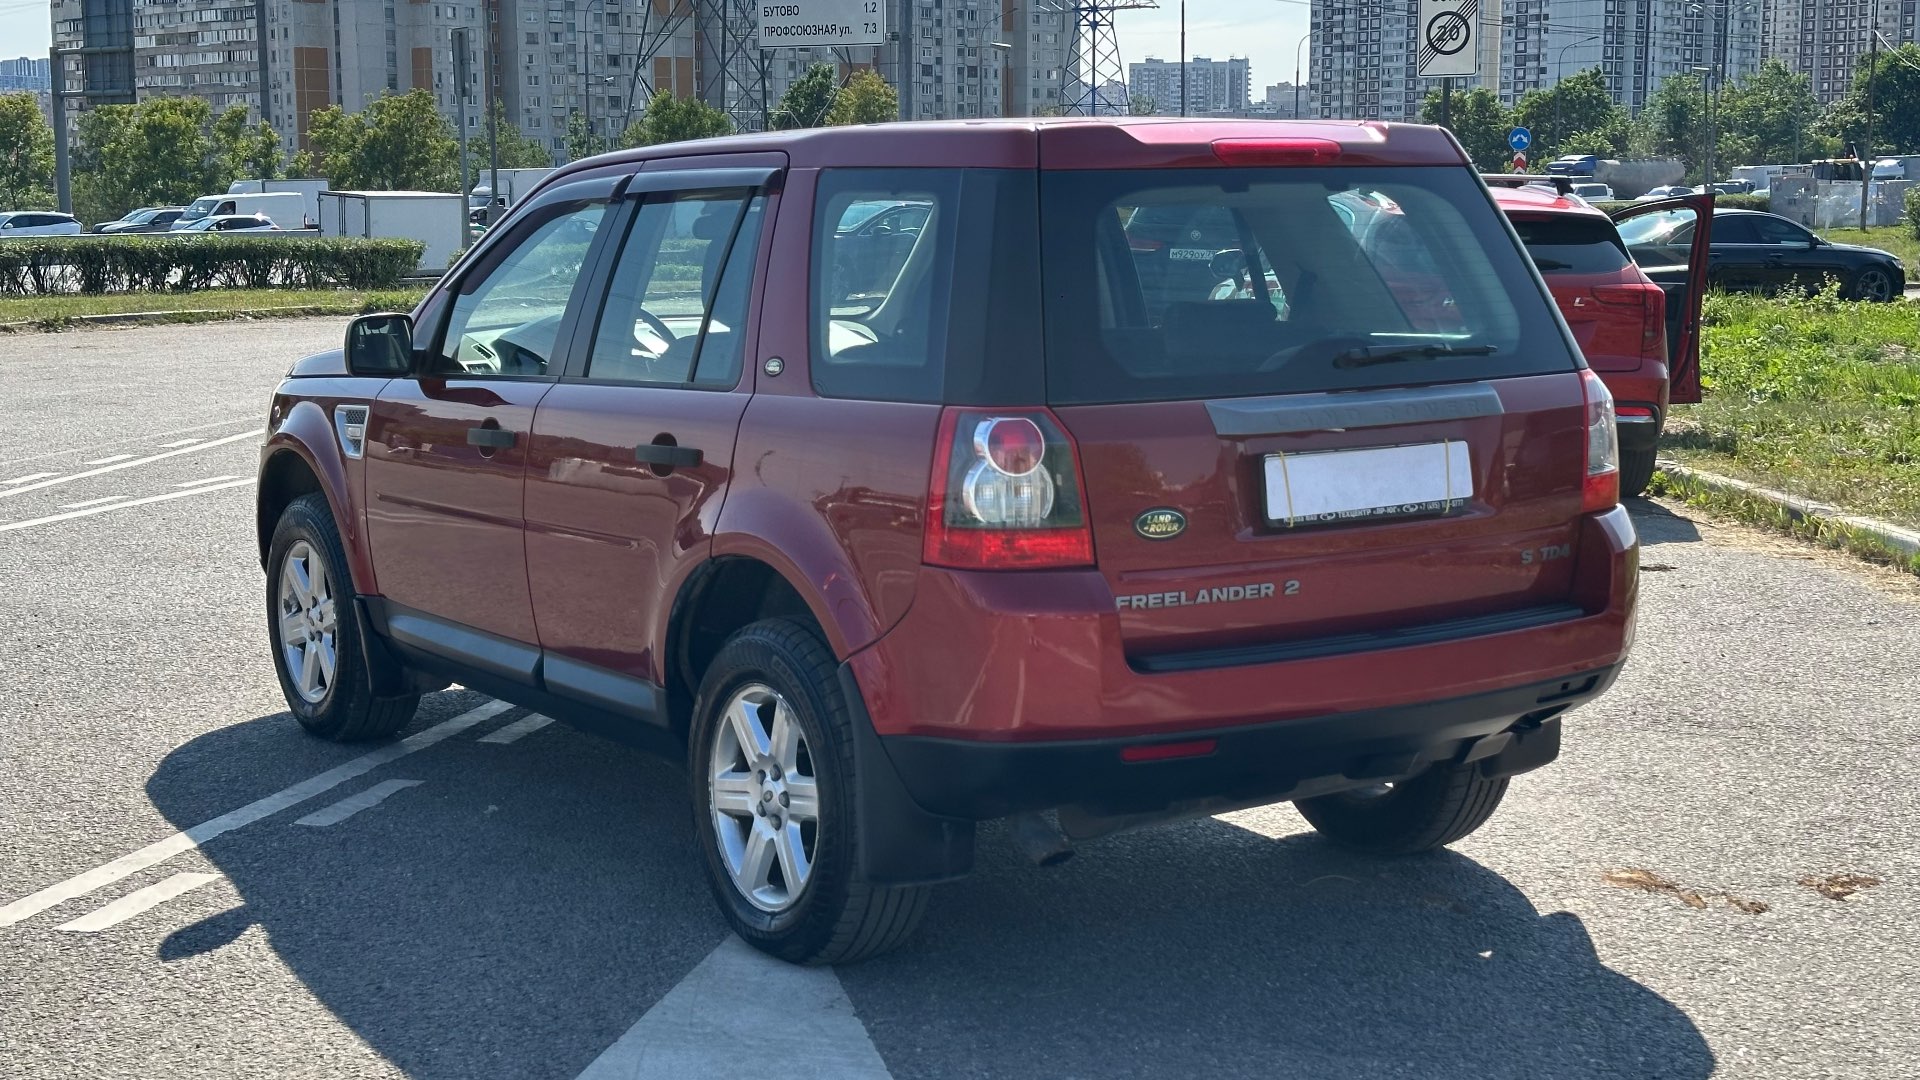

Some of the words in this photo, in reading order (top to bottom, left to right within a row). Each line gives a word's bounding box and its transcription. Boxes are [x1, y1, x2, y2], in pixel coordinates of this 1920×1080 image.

[763, 5, 799, 17] БУТОВО
[864, 2, 877, 13] 1.2
[764, 24, 837, 37] ПРОФСОЮЗНАЯ
[839, 26, 853, 37] ул.
[864, 23, 877, 34] 7.3
[1437, 25, 1459, 41] 20
[1521, 549, 1533, 564] S
[1115, 583, 1275, 610] FREELANDER
[1284, 580, 1300, 596] 2
